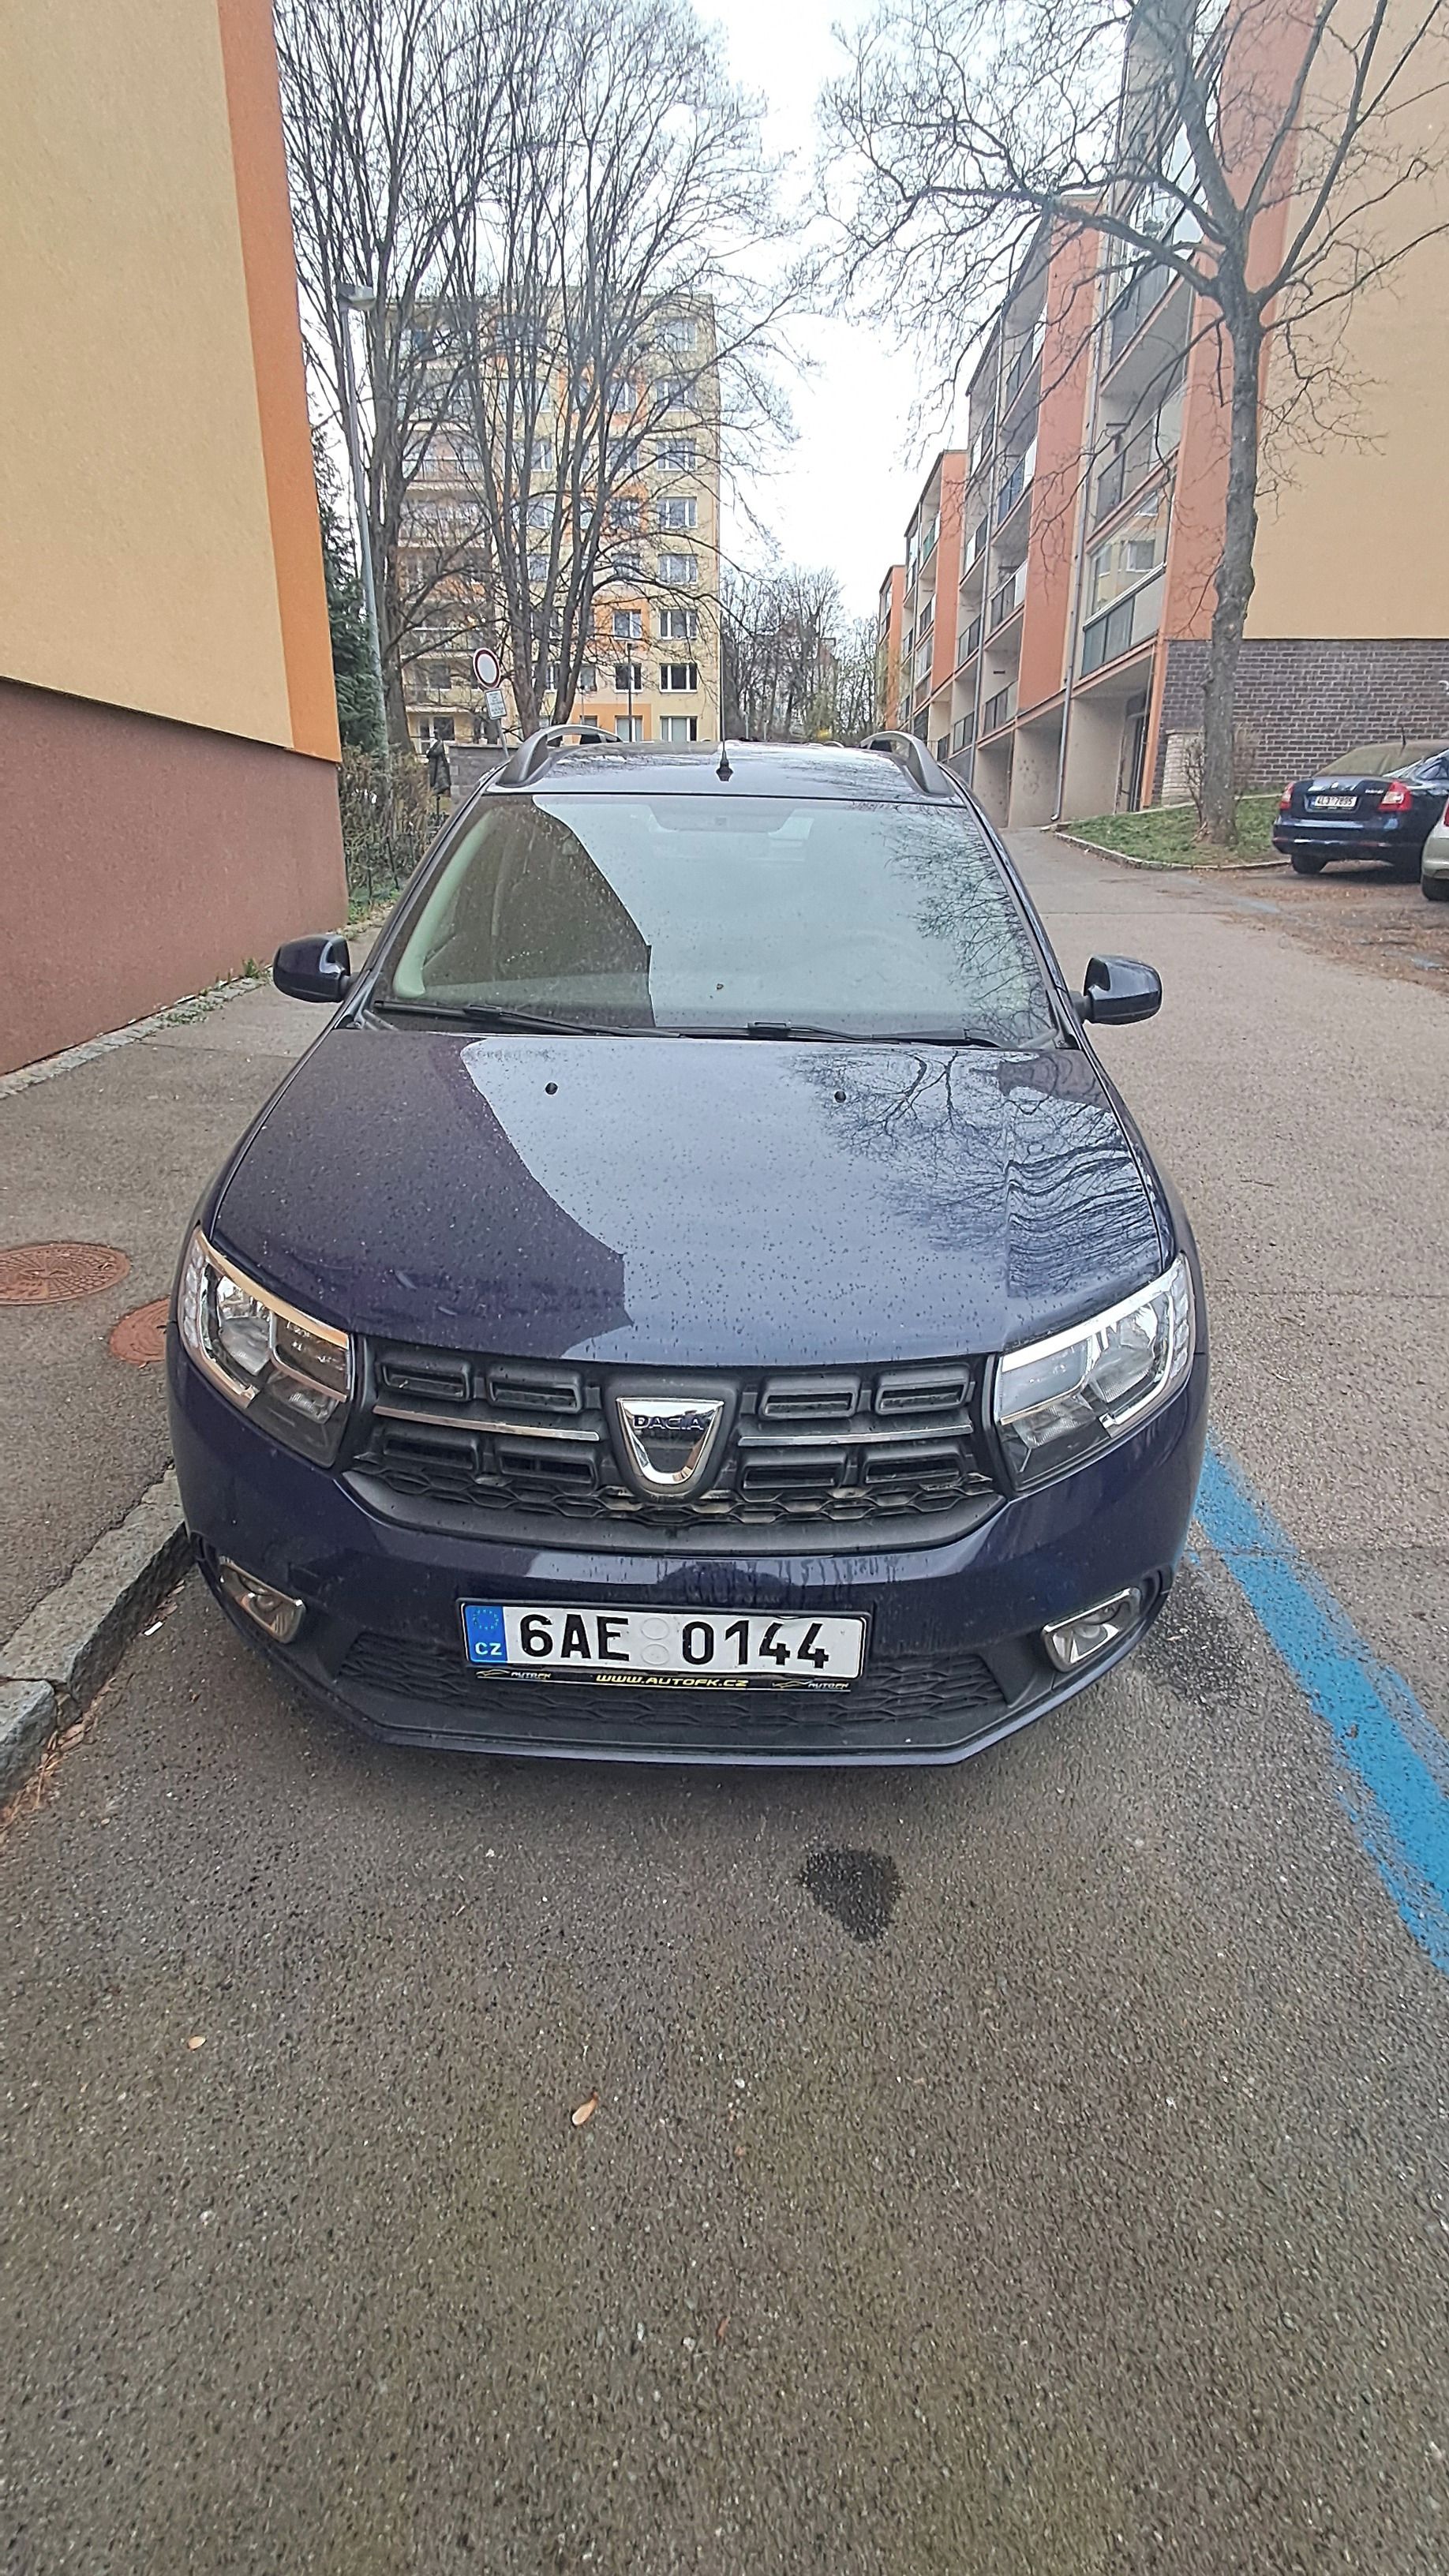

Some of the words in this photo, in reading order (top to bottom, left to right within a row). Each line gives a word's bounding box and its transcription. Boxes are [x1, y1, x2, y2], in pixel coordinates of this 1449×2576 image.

[632, 1415, 704, 1431] DACIA
[475, 1642, 502, 1656] CZ
[519, 1614, 630, 1662] 6AE
[682, 1619, 829, 1669] 0144
[596, 1675, 749, 1687] WWW.AUTOFK.CZ
